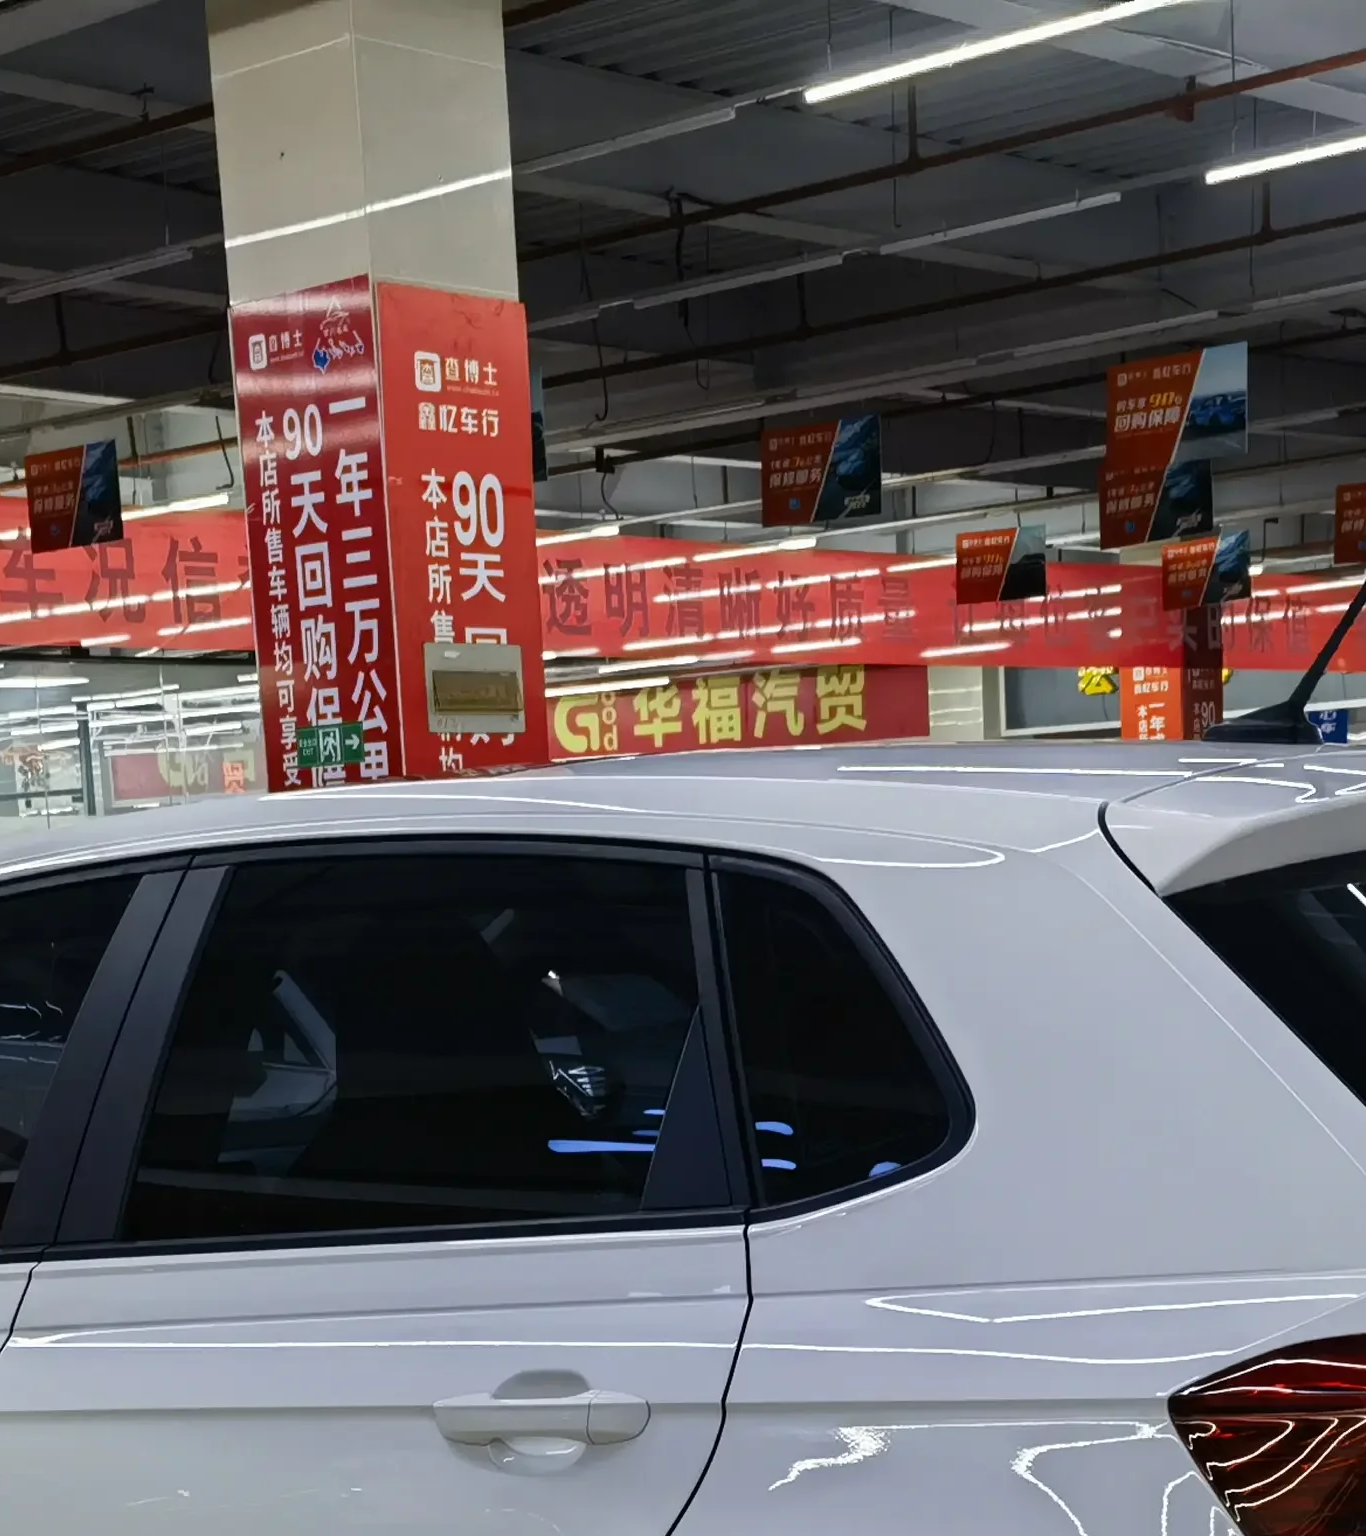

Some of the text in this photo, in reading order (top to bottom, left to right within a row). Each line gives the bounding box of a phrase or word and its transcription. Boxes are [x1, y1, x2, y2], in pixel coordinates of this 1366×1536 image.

[445, 357, 498, 386] 查博士
[418, 402, 499, 437] 鑫忆车行
[255, 410, 302, 787] 本店所售车辆均可享受
[633, 665, 868, 748] 华福汽贸
